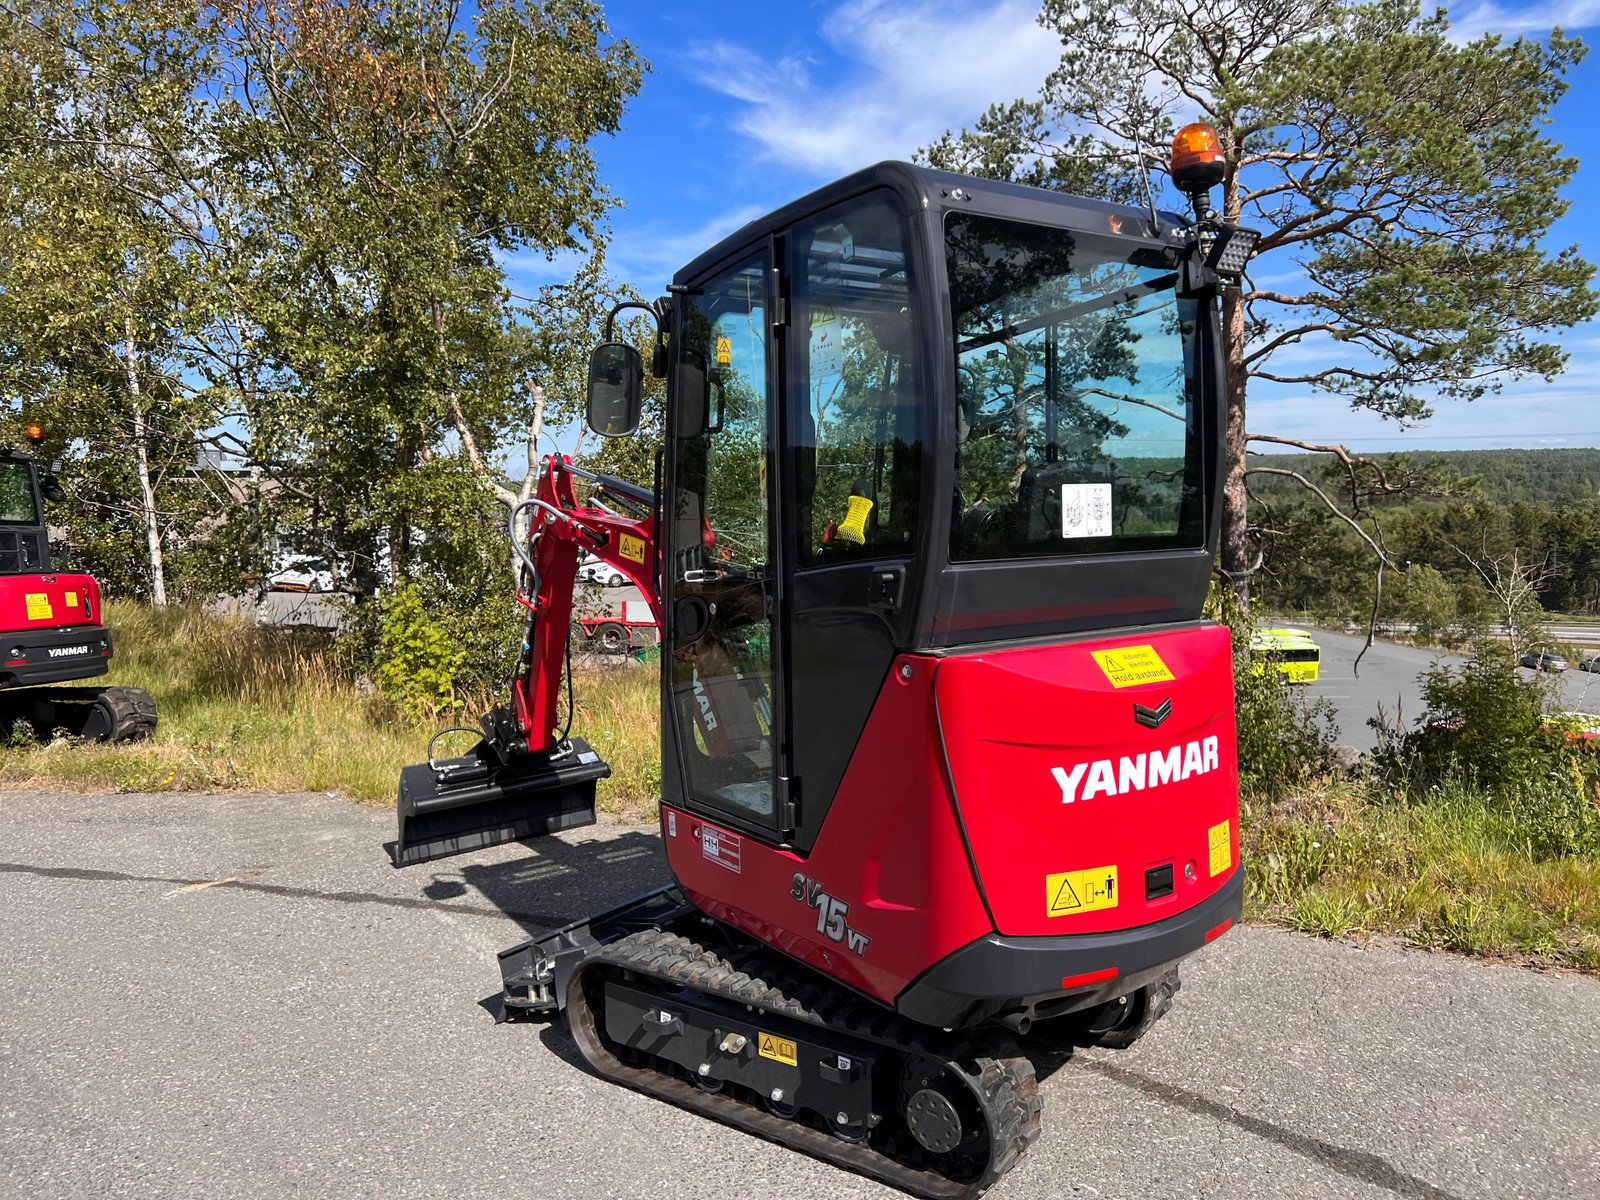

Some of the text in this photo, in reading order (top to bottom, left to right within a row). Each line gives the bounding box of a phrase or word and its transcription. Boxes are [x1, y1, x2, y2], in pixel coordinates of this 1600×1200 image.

[48, 645, 88, 657] YANMAR
[1112, 668, 1167, 683] Hold avstand
[1051, 735, 1219, 804] YANMAR
